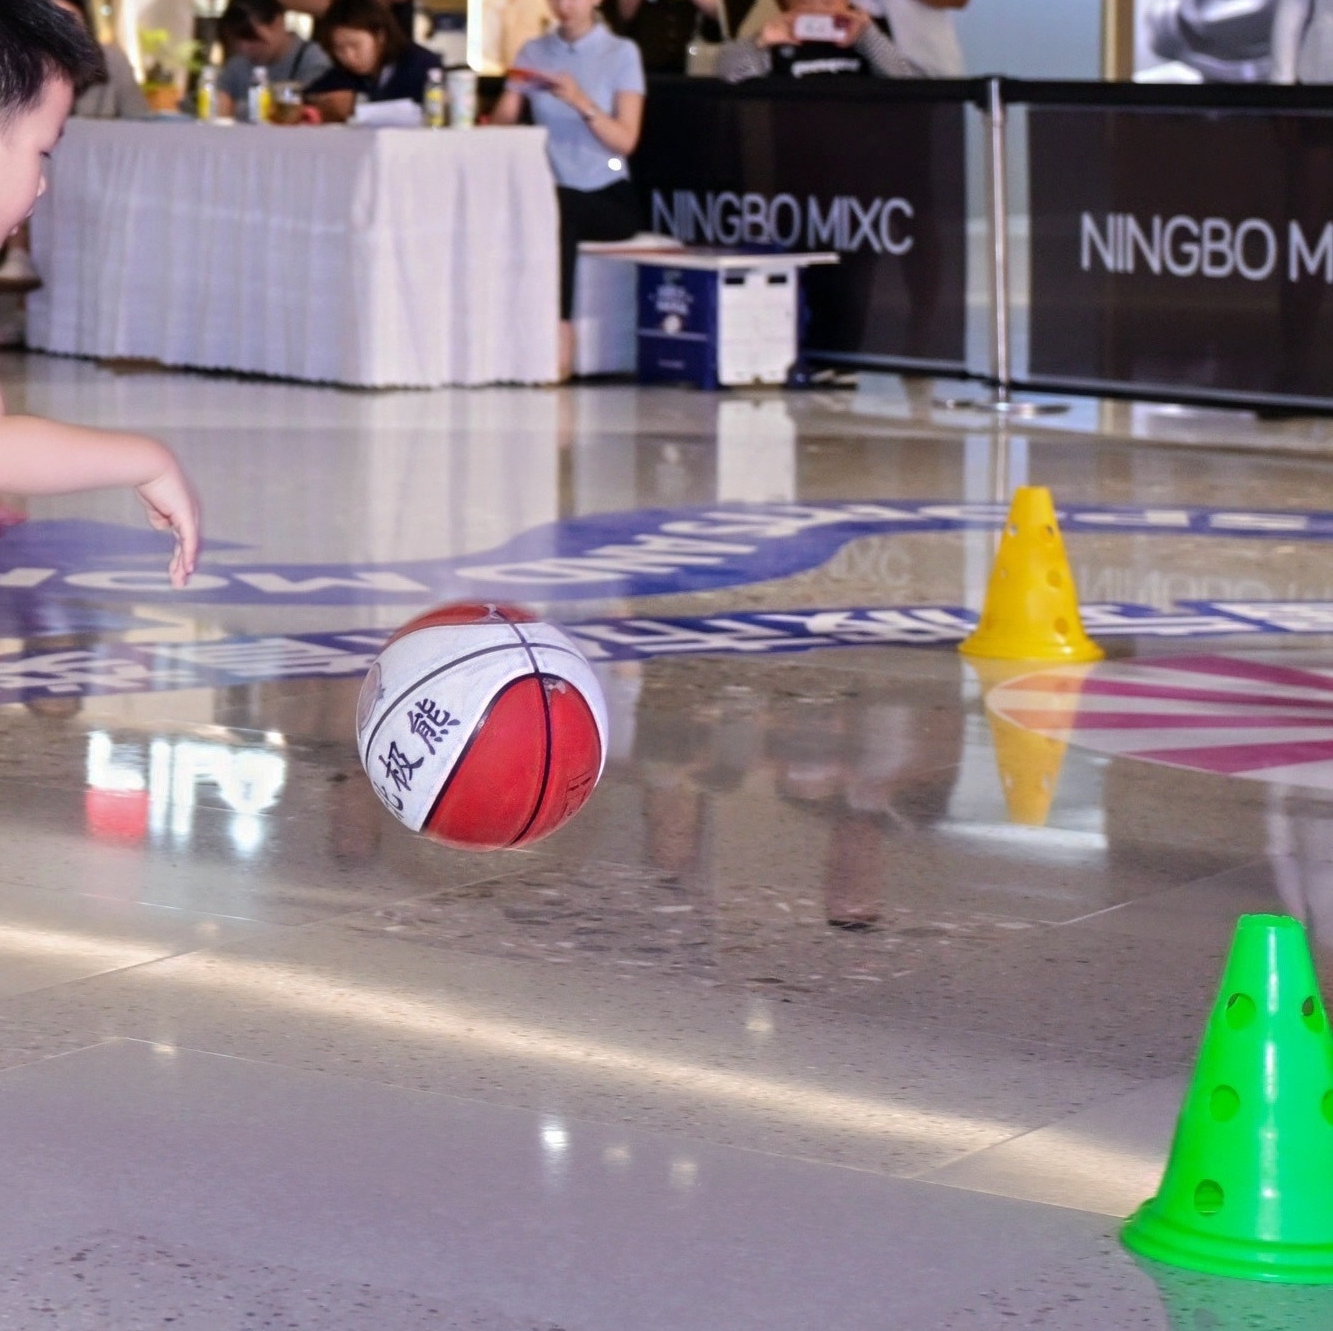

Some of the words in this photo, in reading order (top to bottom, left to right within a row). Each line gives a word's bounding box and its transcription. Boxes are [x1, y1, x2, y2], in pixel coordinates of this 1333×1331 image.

[652, 188, 802, 249] NINGBO
[807, 194, 914, 255] MIXC
[1081, 211, 1278, 281] NINGBO
[455, 533, 758, 584] AND
